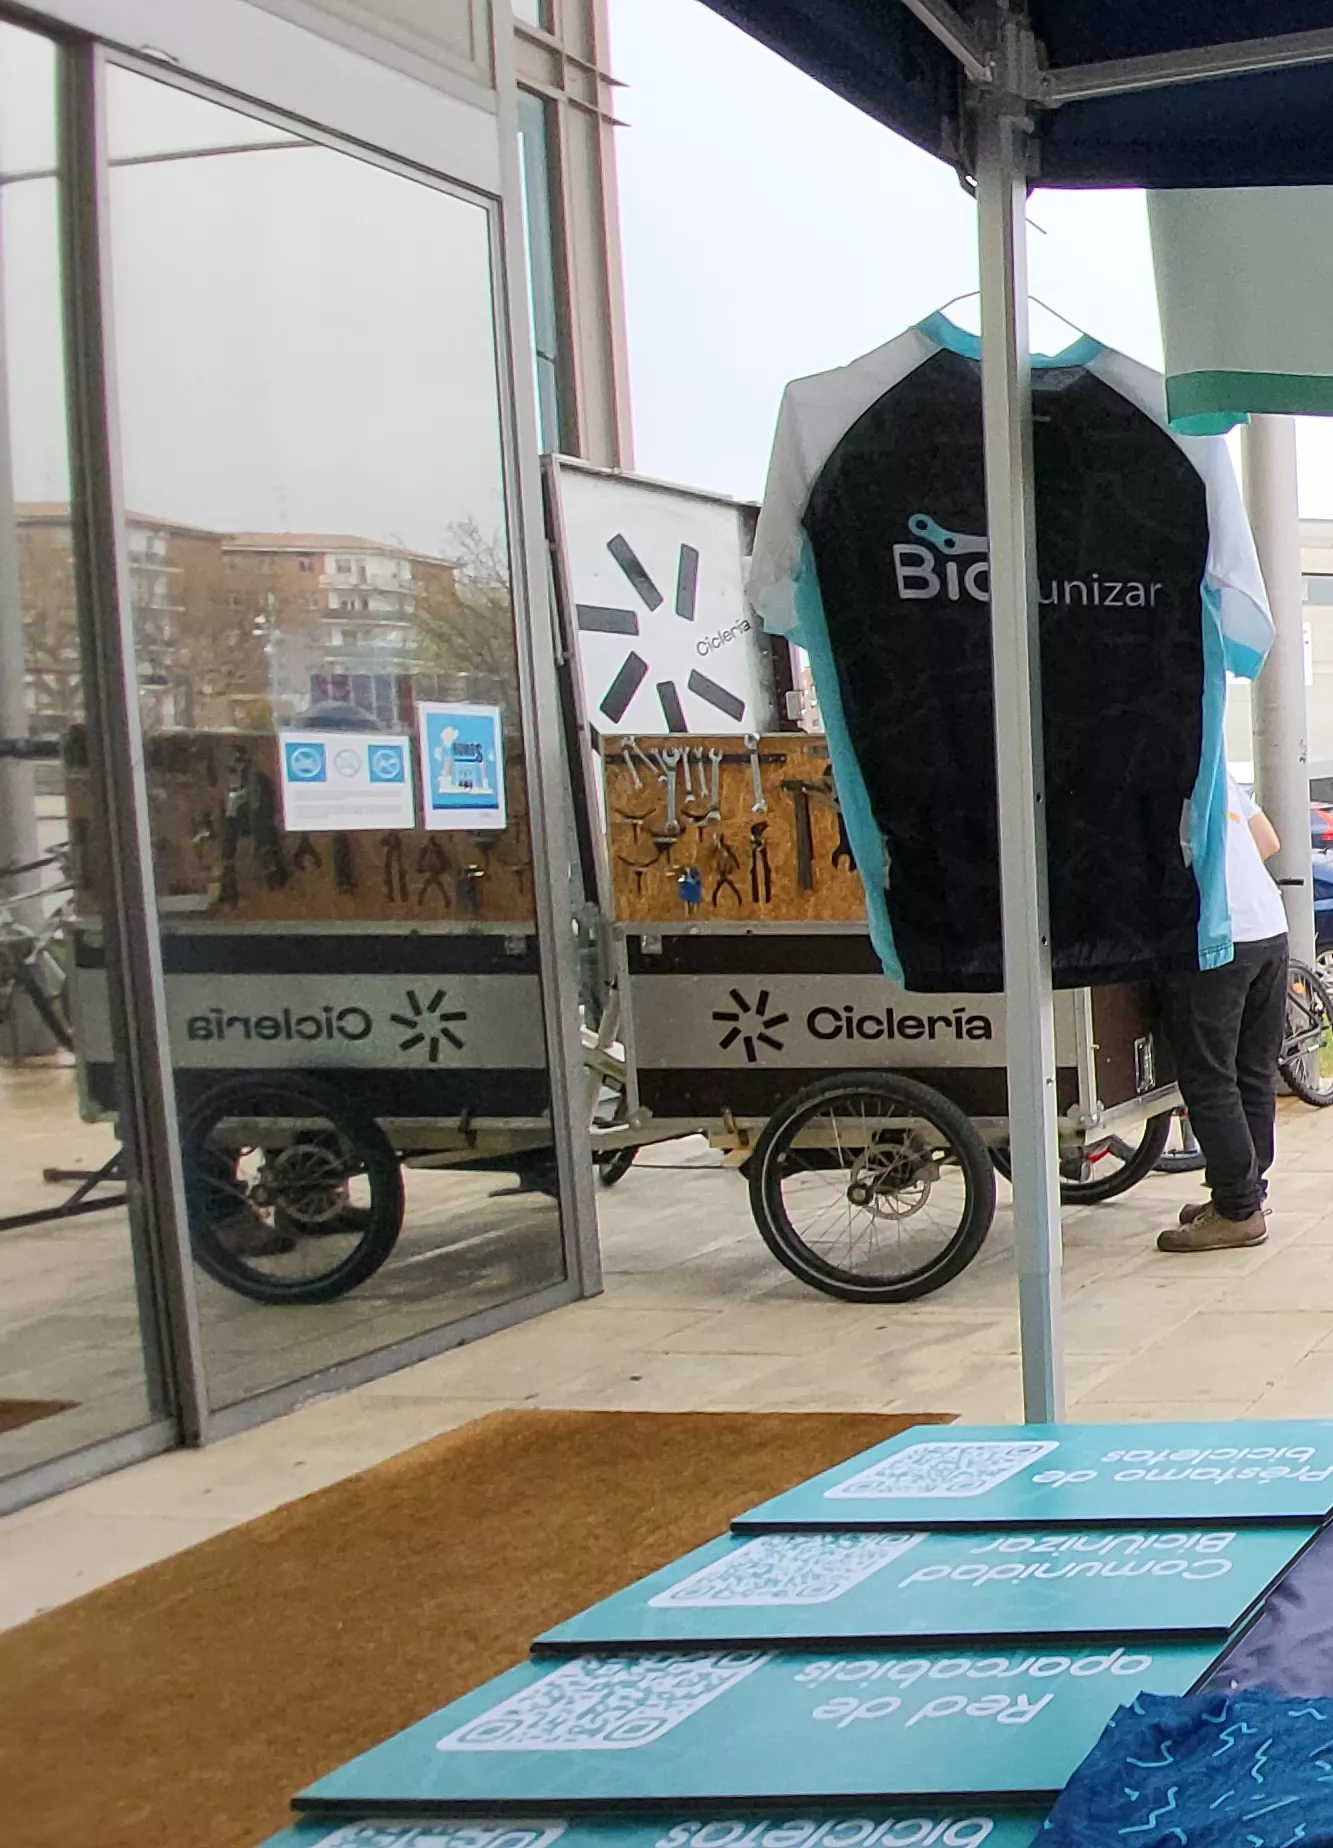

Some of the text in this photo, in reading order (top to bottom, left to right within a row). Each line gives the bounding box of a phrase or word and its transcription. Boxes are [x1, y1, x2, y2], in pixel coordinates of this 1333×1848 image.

[806, 1006, 993, 1042] Ciclería
[1101, 1446, 1316, 1464] bicicletas
[1032, 1468, 1102, 1489] de
[973, 1532, 1238, 1554] BiciUnizar
[897, 1558, 1233, 1588] Comunidad
[794, 1648, 1152, 1690] aparcabicis
[812, 1693, 1055, 1730] Red de
[655, 1817, 995, 1848] bicicletas
